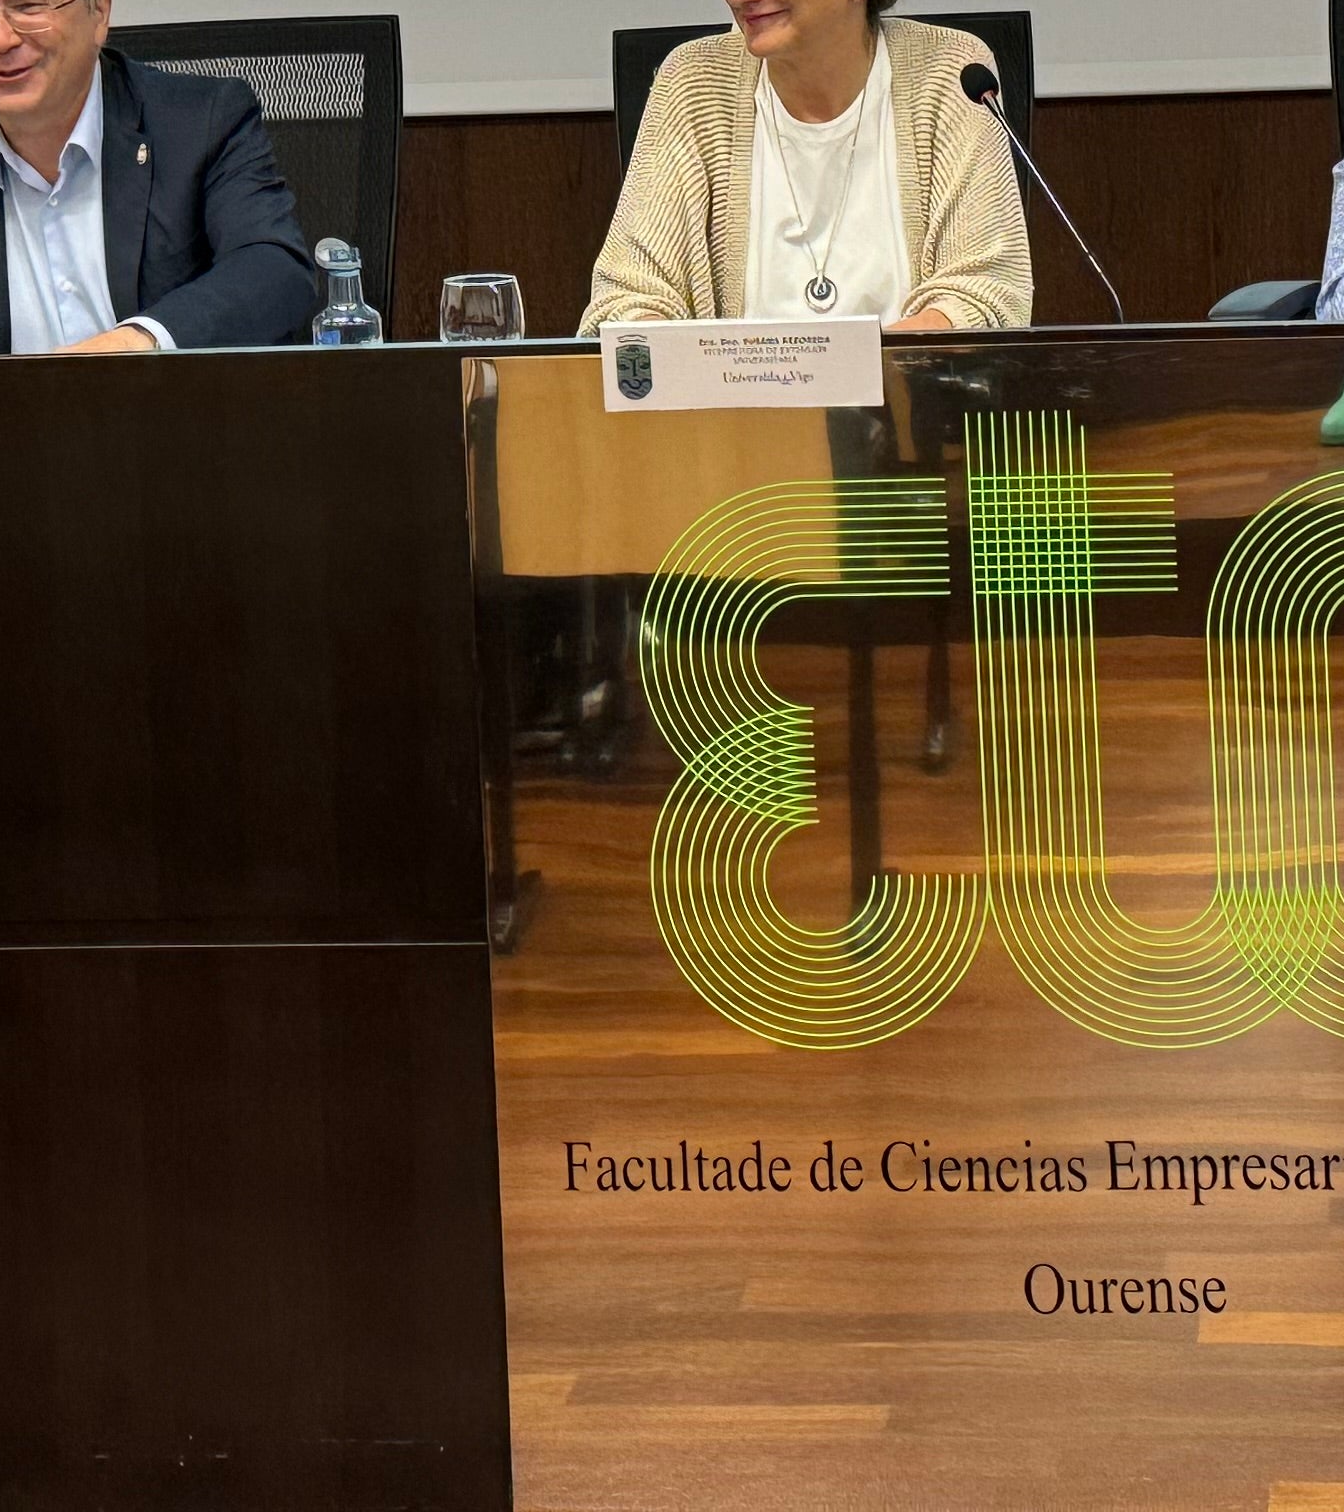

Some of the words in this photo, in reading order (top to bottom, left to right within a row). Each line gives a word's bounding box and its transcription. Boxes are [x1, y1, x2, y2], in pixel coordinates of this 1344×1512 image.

[562, 1140, 792, 1195] Facultade
[808, 1140, 865, 1194] de
[880, 1139, 1088, 1194] Ciencias
[1022, 1262, 1227, 1317] Ourense
